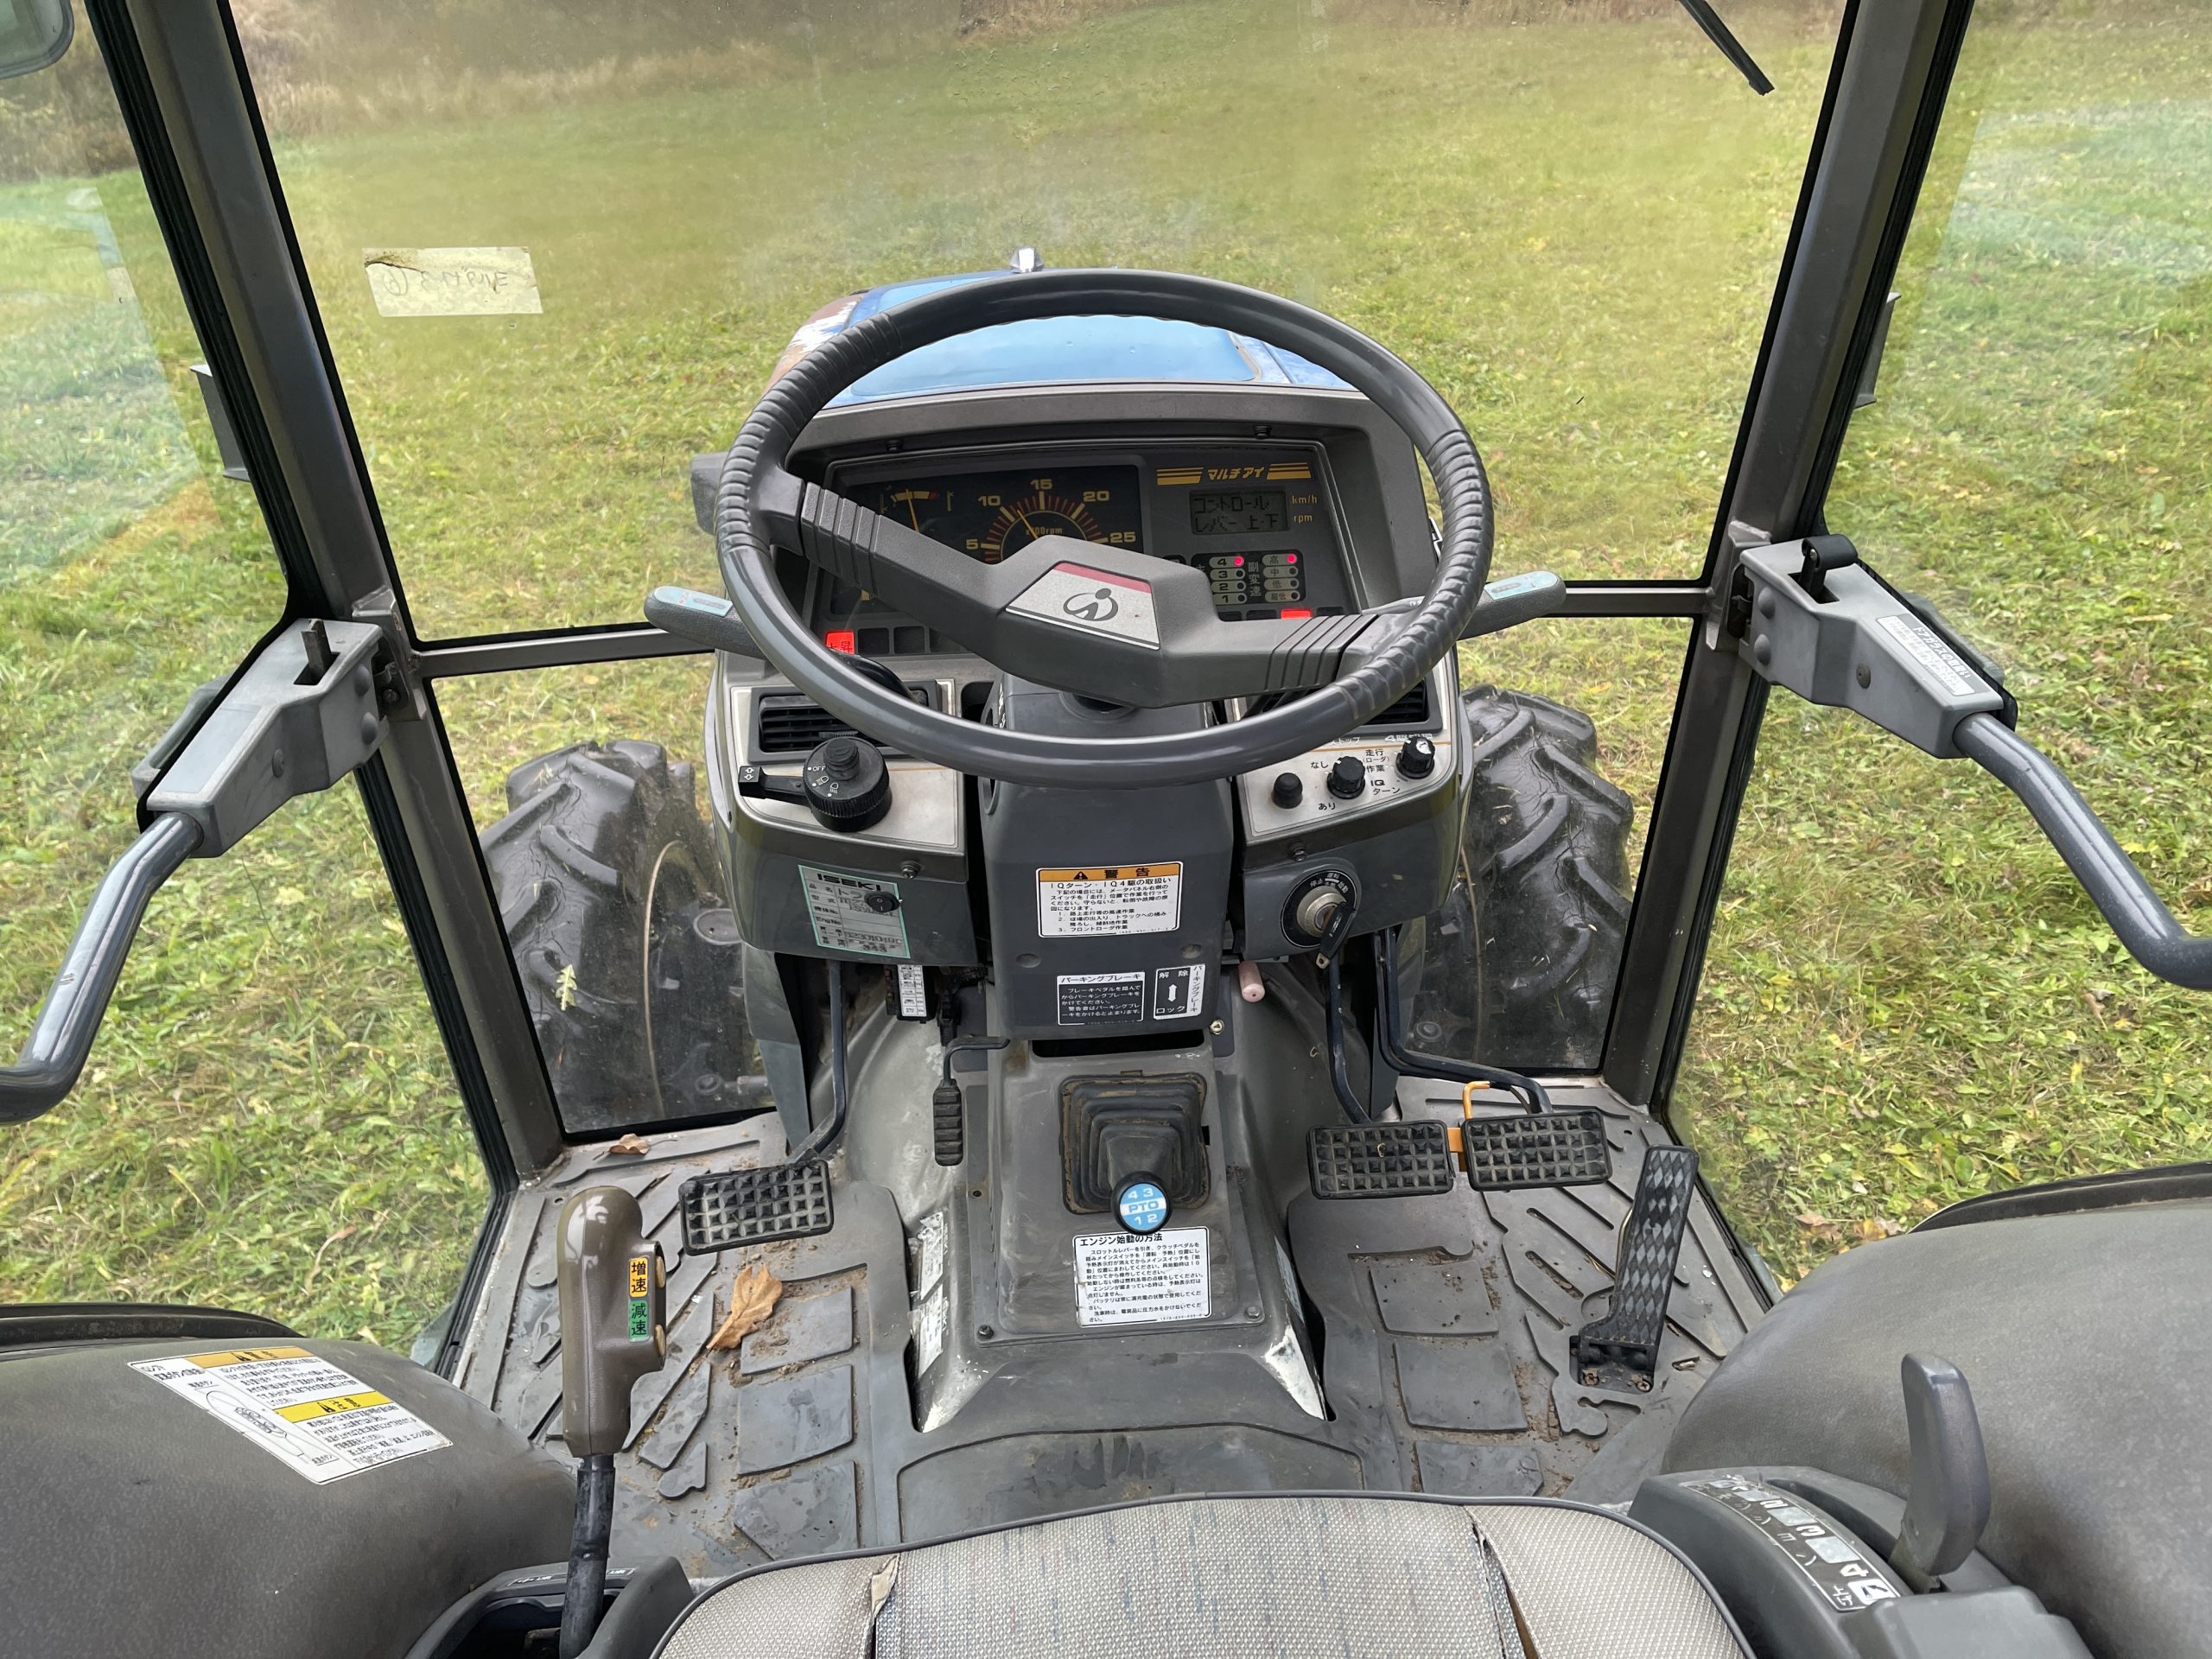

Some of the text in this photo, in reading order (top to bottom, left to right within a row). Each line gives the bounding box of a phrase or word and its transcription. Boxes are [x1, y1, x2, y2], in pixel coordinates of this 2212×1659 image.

[1208, 467, 1265, 480] マルチアイ
[1031, 479, 1052, 490] 15
[978, 495, 1001, 506] 10
[1083, 491, 1109, 502] 20
[1292, 495, 1317, 505] km/h
[1194, 495, 1268, 514] コントロール
[1294, 513, 1313, 524] rpm
[1109, 531, 1135, 543] 25
[966, 539, 978, 550] 5
[1270, 568, 1279, 576] 中
[1219, 582, 1229, 591] 2
[1310, 760, 1329, 769] なし
[1366, 765, 1385, 773] 作業
[1373, 786, 1401, 795] ターン
[1318, 802, 1336, 810] あり
[1104, 868, 1150, 880] 警告
[817, 873, 880, 891] ISEKI
[1061, 974, 1141, 983] パーキングブレーキ
[1159, 970, 1189, 979] 解除
[1192, 966, 1203, 1013] パーキングブレーキ
[1128, 1188, 1154, 1199] 4 3
[1128, 1200, 1160, 1213] PTO
[1135, 1213, 1159, 1225] 1 2
[1080, 1233, 1163, 1247] エンジン始動の方法
[631, 1262, 647, 1293] 増速
[631, 1303, 647, 1336] 減速
[1840, 1563, 1870, 1578] 4
[1833, 1585, 1853, 1606] 上げ
